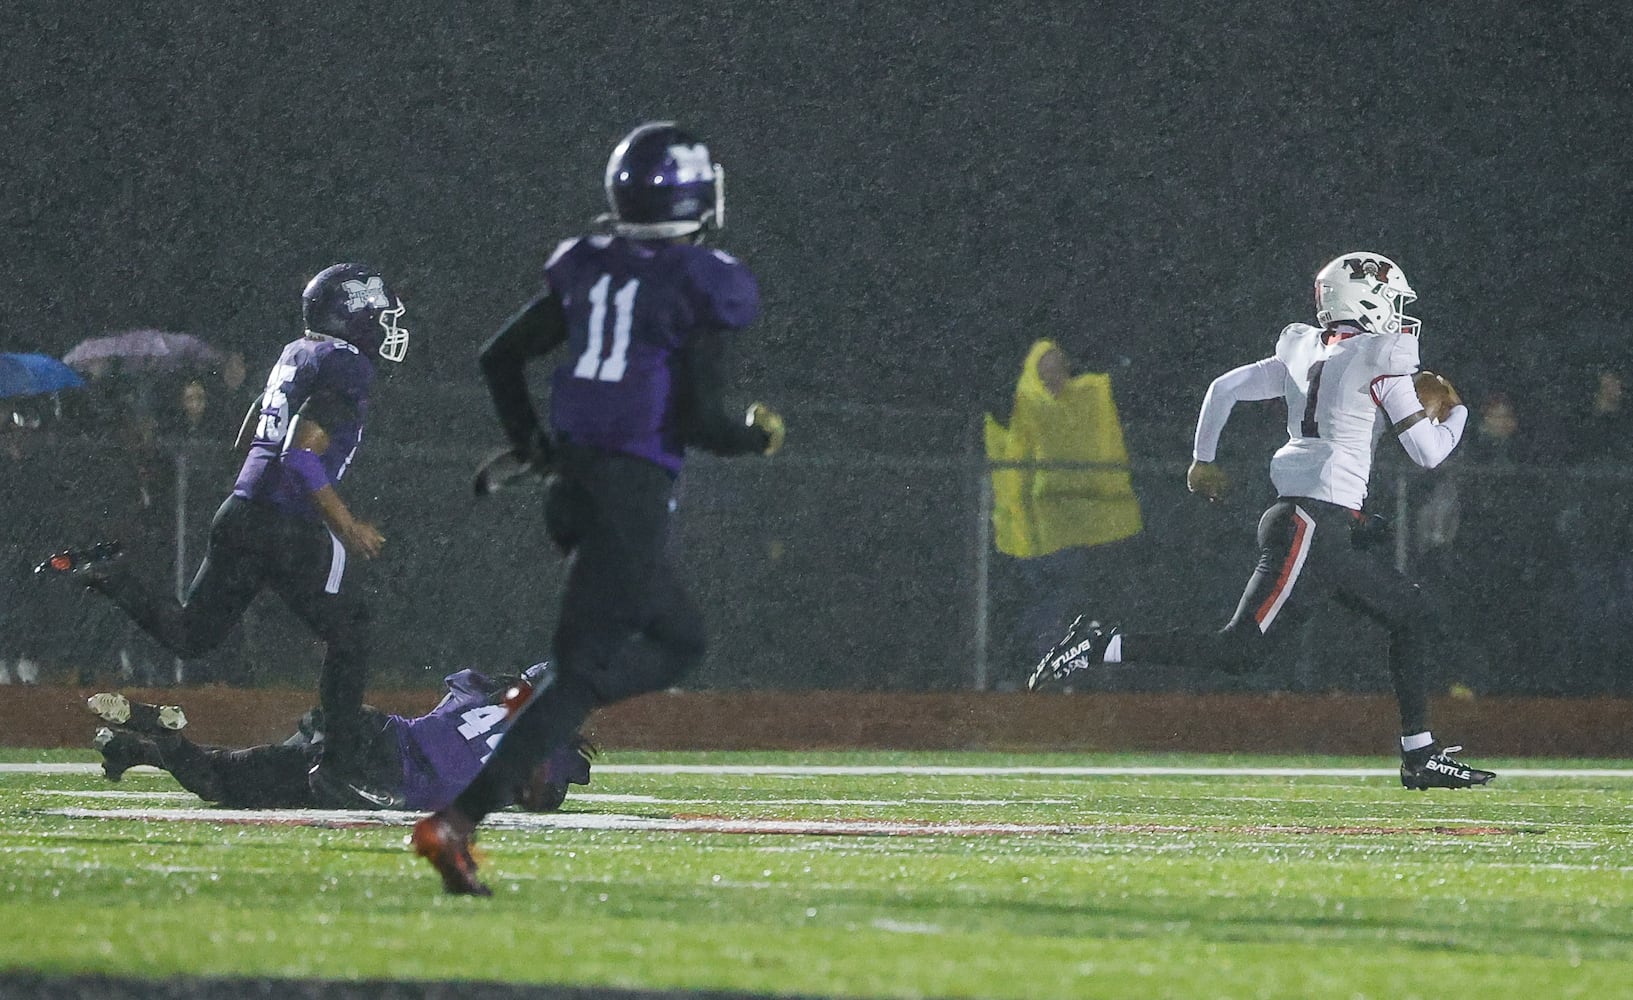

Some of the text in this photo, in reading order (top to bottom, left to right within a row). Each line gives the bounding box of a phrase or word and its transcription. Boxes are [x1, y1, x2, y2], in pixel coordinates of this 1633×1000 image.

[573, 273, 640, 382] 11
[1301, 360, 1326, 439] 1
[1050, 639, 1091, 672] BATTLE
[1425, 759, 1472, 781] BATTLE
